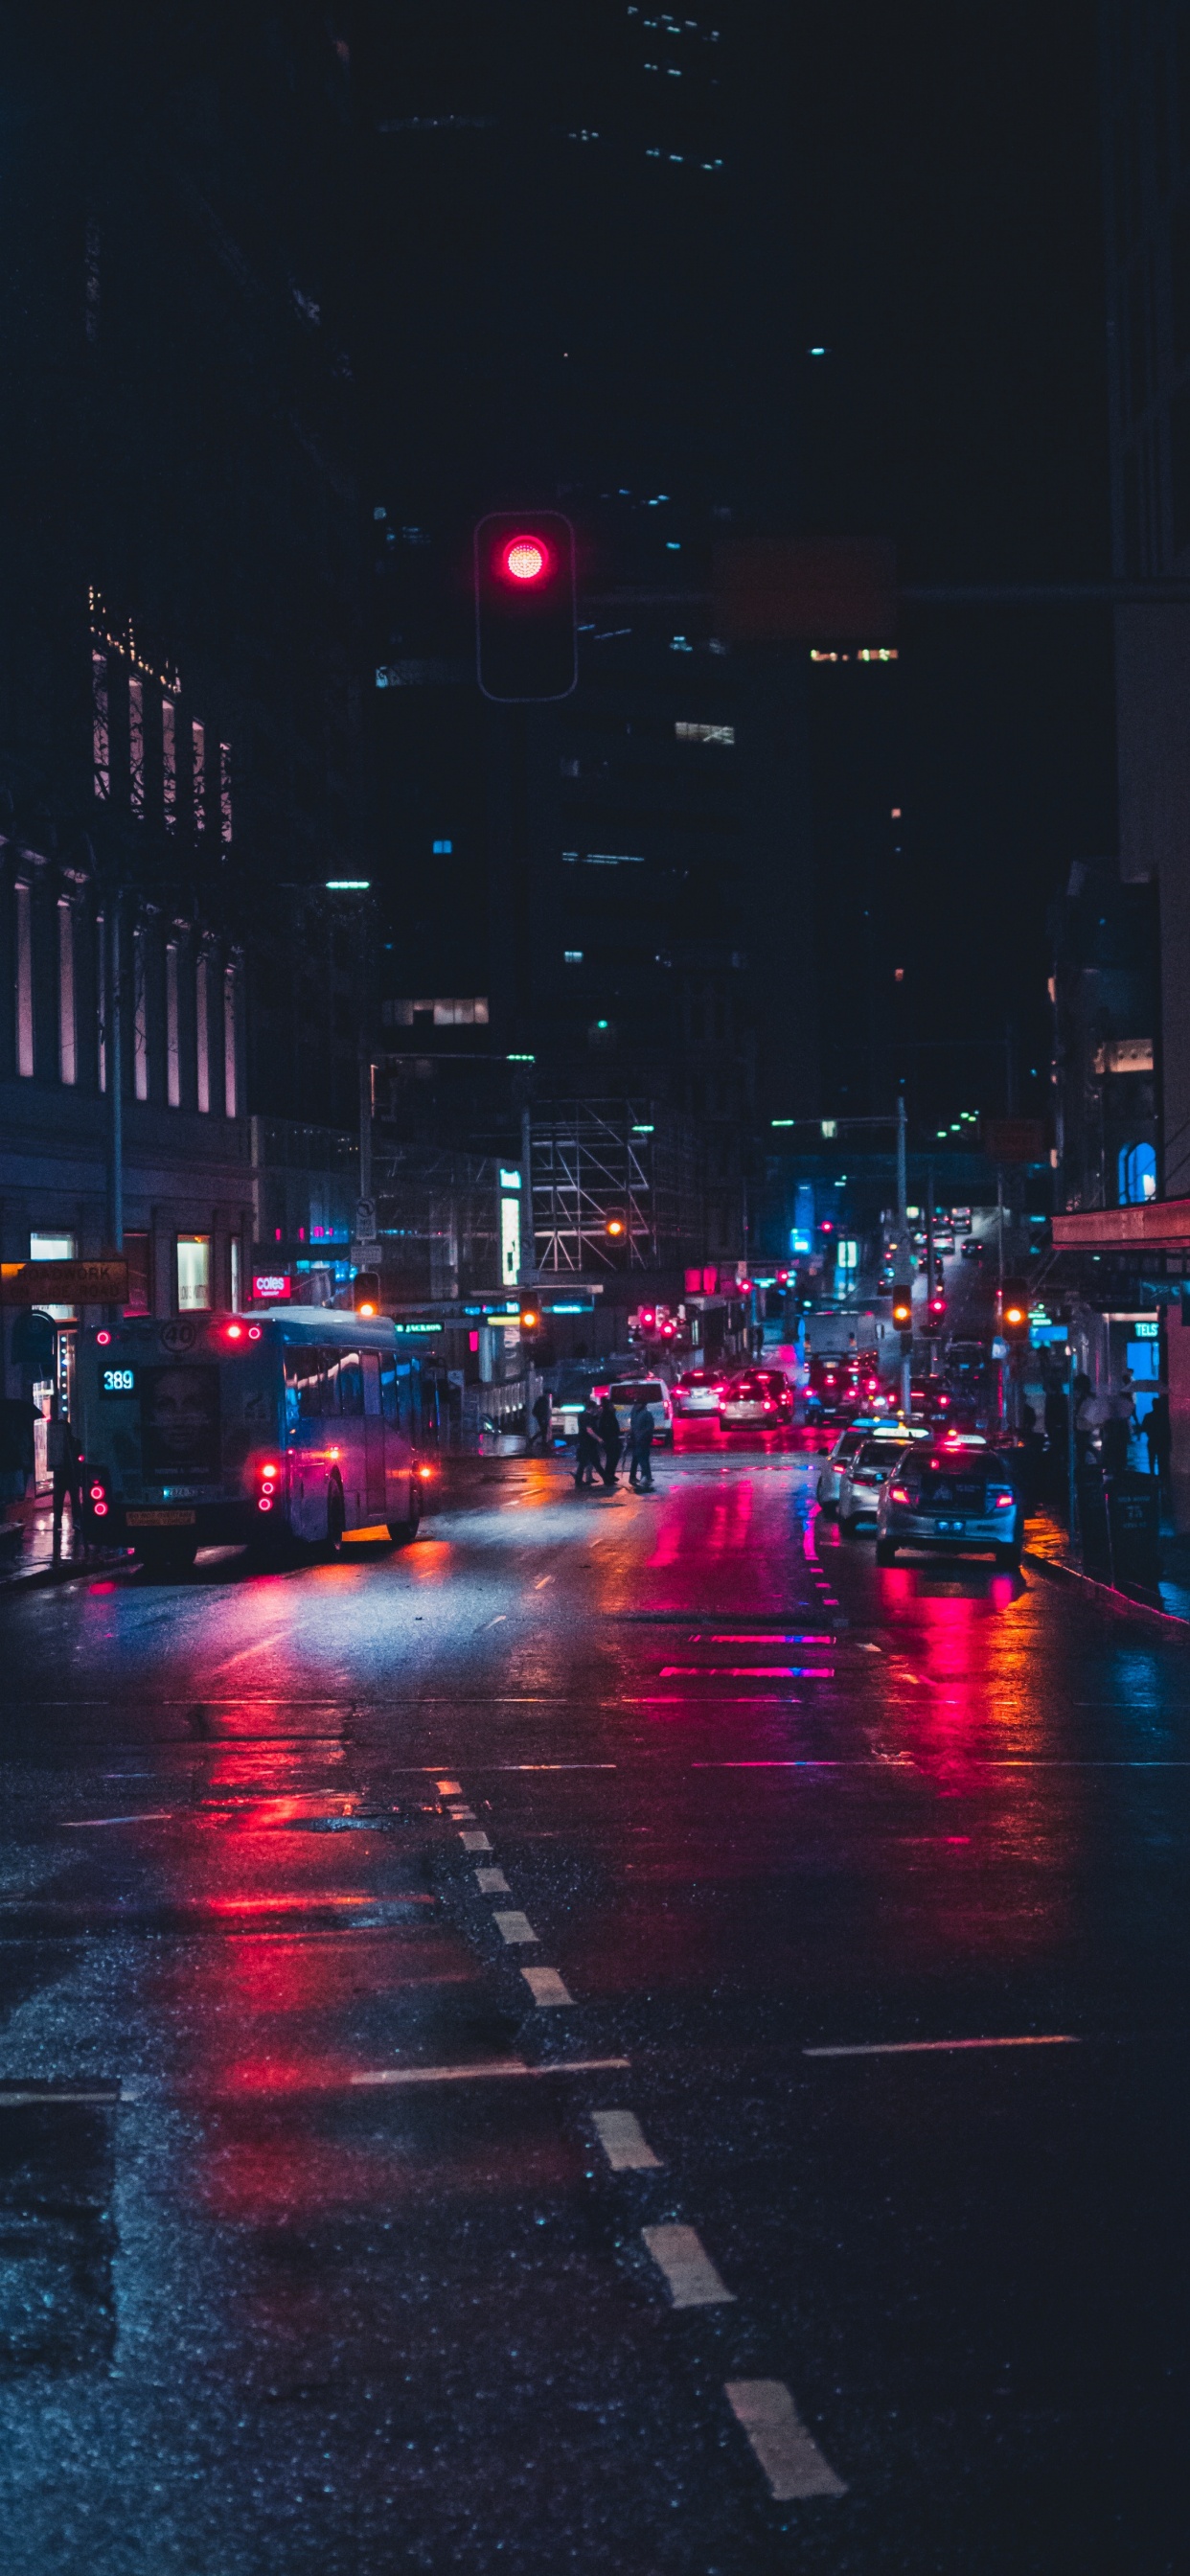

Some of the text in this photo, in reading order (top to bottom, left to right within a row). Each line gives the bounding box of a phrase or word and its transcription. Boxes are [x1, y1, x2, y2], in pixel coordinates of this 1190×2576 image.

[19, 1267, 110, 1281] ROADWORK
[256, 1276, 285, 1290] coles
[79, 1284, 120, 1298] ROAD
[165, 1326, 194, 1344] 40
[1134, 1322, 1160, 1337] TELS
[103, 1369, 135, 1391] 389
